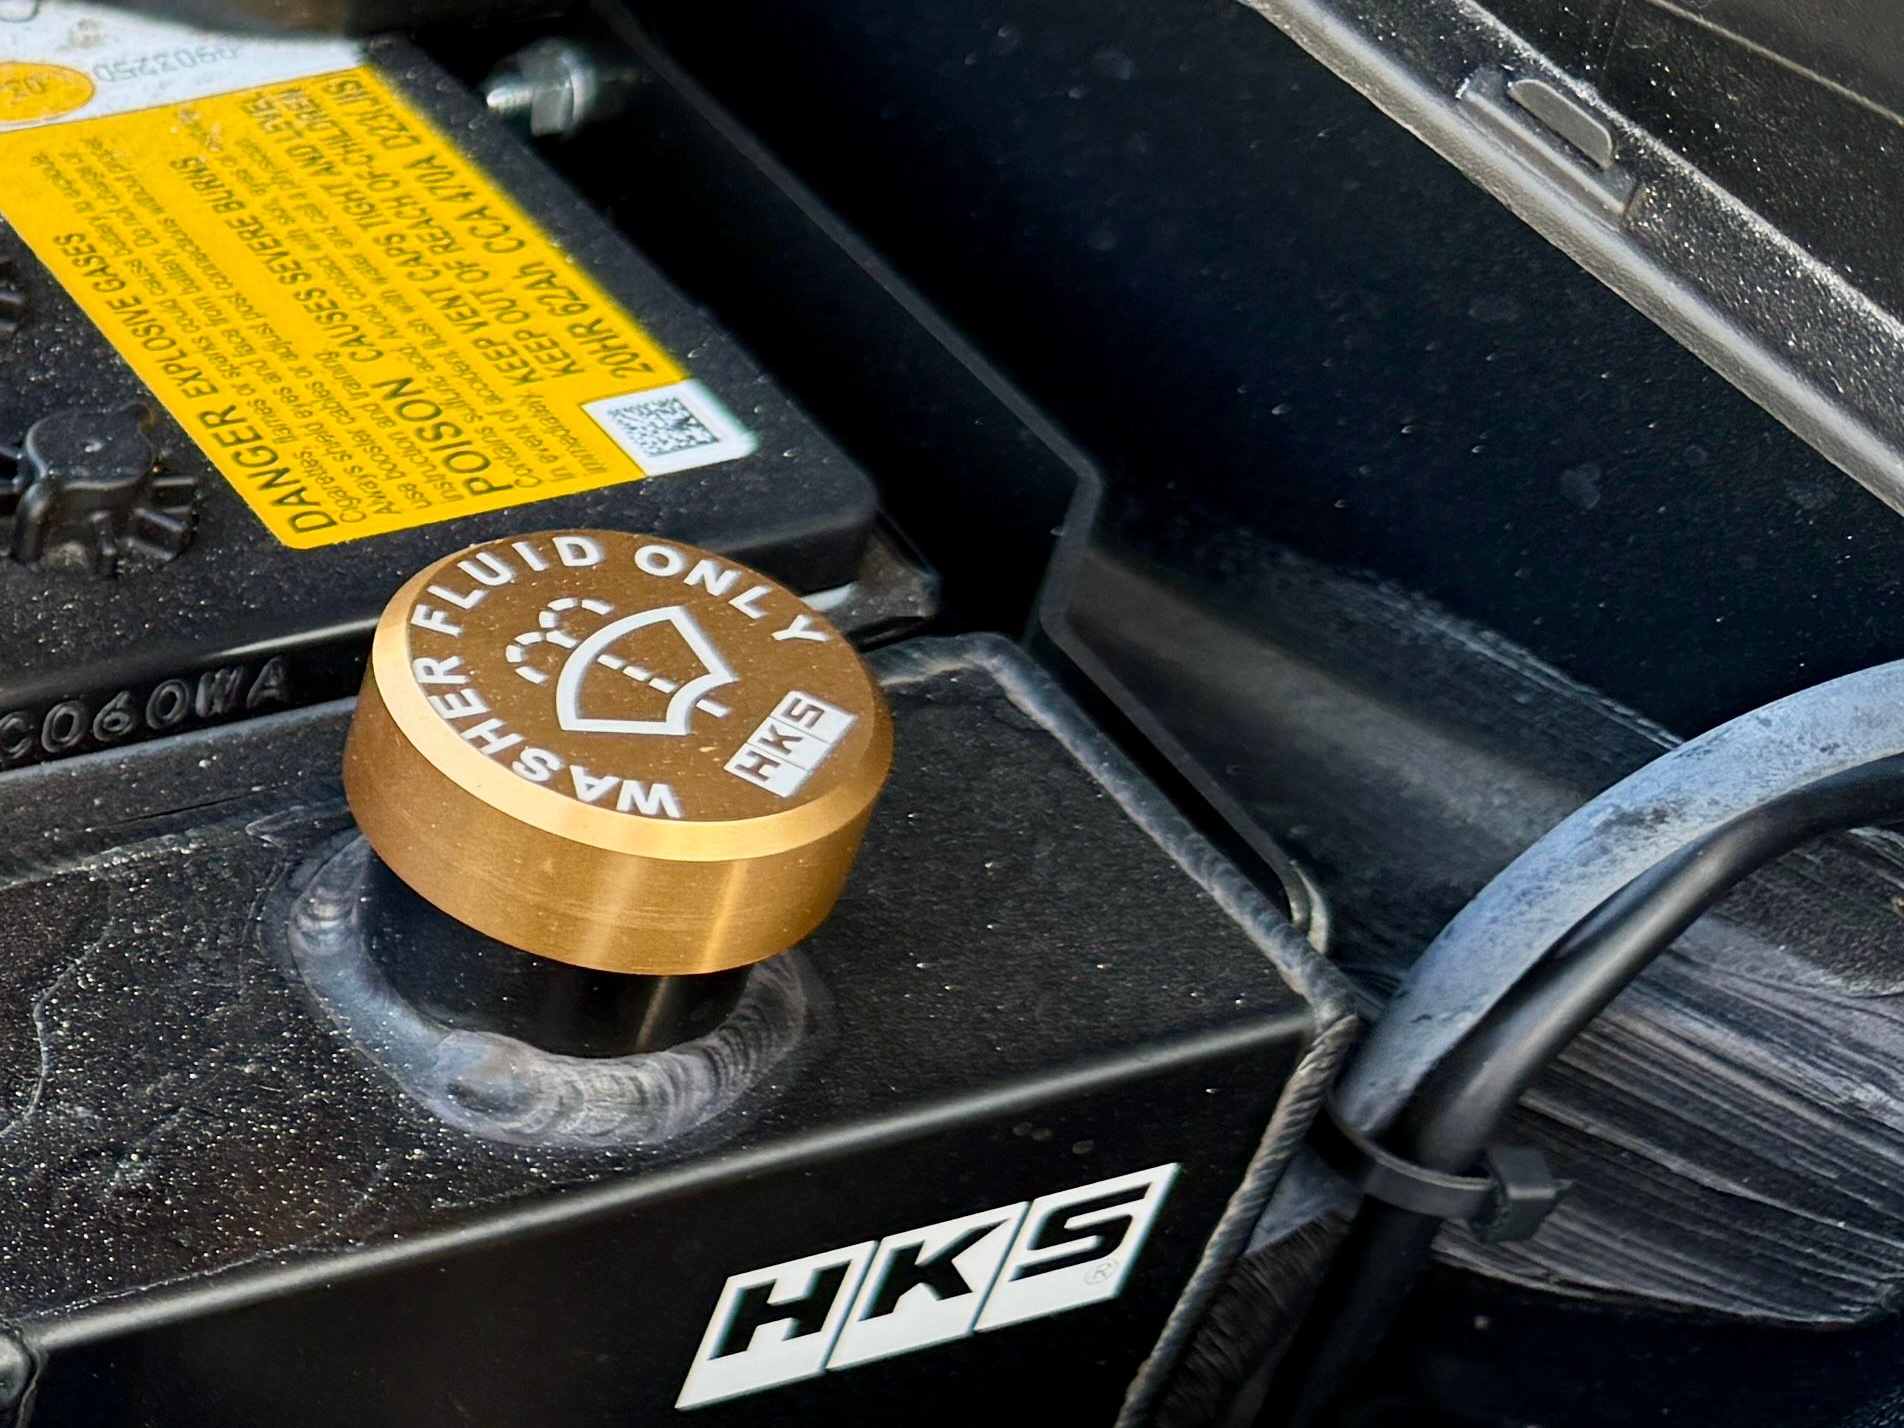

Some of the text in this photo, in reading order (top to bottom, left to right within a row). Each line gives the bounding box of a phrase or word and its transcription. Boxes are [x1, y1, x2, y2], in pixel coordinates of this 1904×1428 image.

[394, 153, 481, 207] 470A
[228, 90, 546, 386] KEEP VENT CAPS TIGHT AND LEVEL
[378, 193, 467, 256] REACH
[445, 204, 531, 256] CCA
[439, 255, 495, 285] OF
[502, 260, 594, 319] 62Ah
[152, 298, 203, 335] could
[165, 155, 515, 496] POISON CAUSES SEVERE BURNS
[185, 295, 233, 327] from
[467, 283, 535, 326] OUT
[184, 334, 246, 380] sparks
[213, 327, 261, 358] face
[242, 320, 307, 364] adjust
[507, 324, 587, 378] KEEP
[559, 316, 657, 380] 20HR
[49, 230, 338, 533] DANGER EXPLOSIVE GASES
[230, 381, 258, 396] or
[241, 358, 285, 386] and
[285, 363, 316, 379] or
[238, 397, 300, 444] flames
[270, 385, 320, 419] eyes
[296, 380, 359, 427] cables
[414, 374, 485, 425] sulfuric
[484, 407, 521, 424] of
[295, 420, 354, 464] shield
[305, 347, 465, 503] instruction and training.
[501, 423, 561, 465] event
[339, 427, 407, 481] booster
[464, 425, 546, 490] Contains
[541, 465, 577, 482] In
[280, 444, 376, 524] Cigarettes,
[334, 462, 407, 518] Always
[393, 481, 434, 509] use
[410, 535, 831, 819] WASHER FLUID ONLY
[729, 695, 838, 790] HKS
[700, 1176, 1160, 1370] HKS
